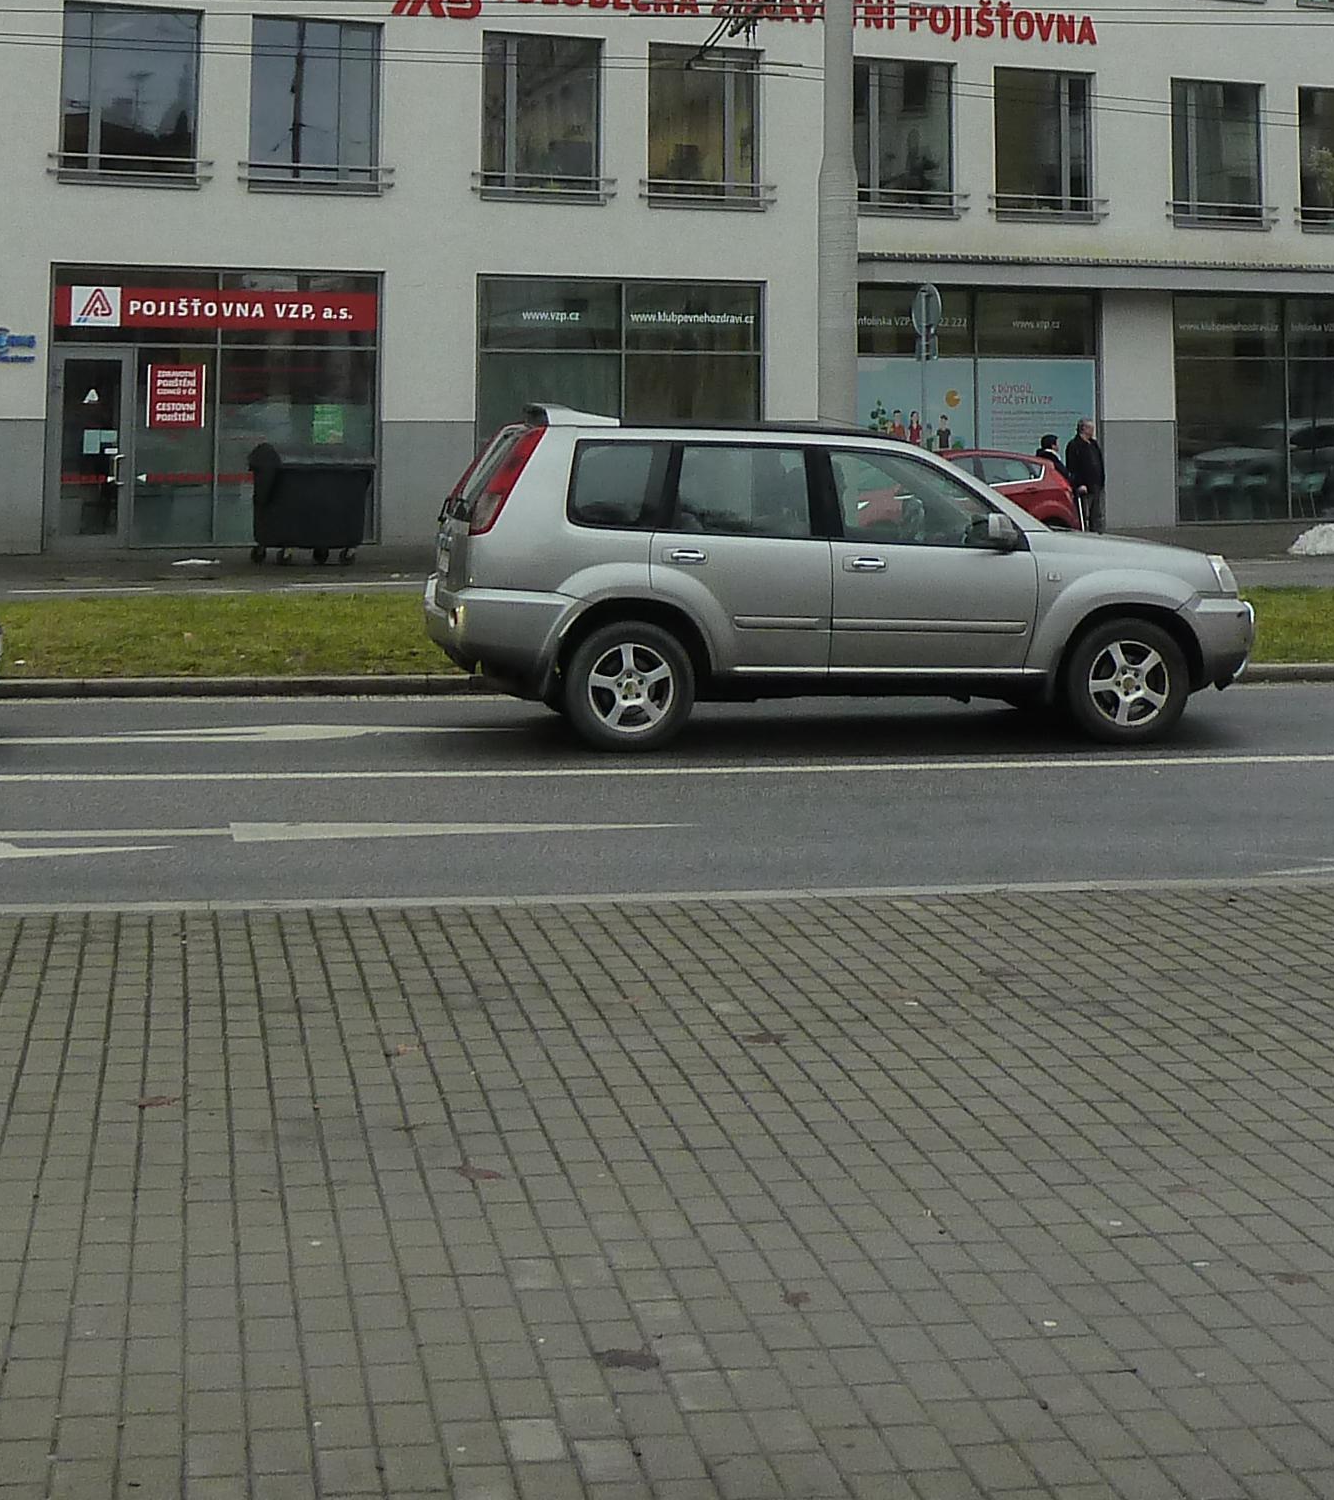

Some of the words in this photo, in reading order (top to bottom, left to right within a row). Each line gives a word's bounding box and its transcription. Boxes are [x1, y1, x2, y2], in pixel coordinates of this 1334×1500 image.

[128, 297, 265, 318] POJIŠŤOVNA
[274, 302, 317, 320] VZP,
[321, 307, 354, 320] a.s.
[521, 310, 581, 323] www.vzp.cz
[155, 400, 197, 411] CESTOVNÍ
